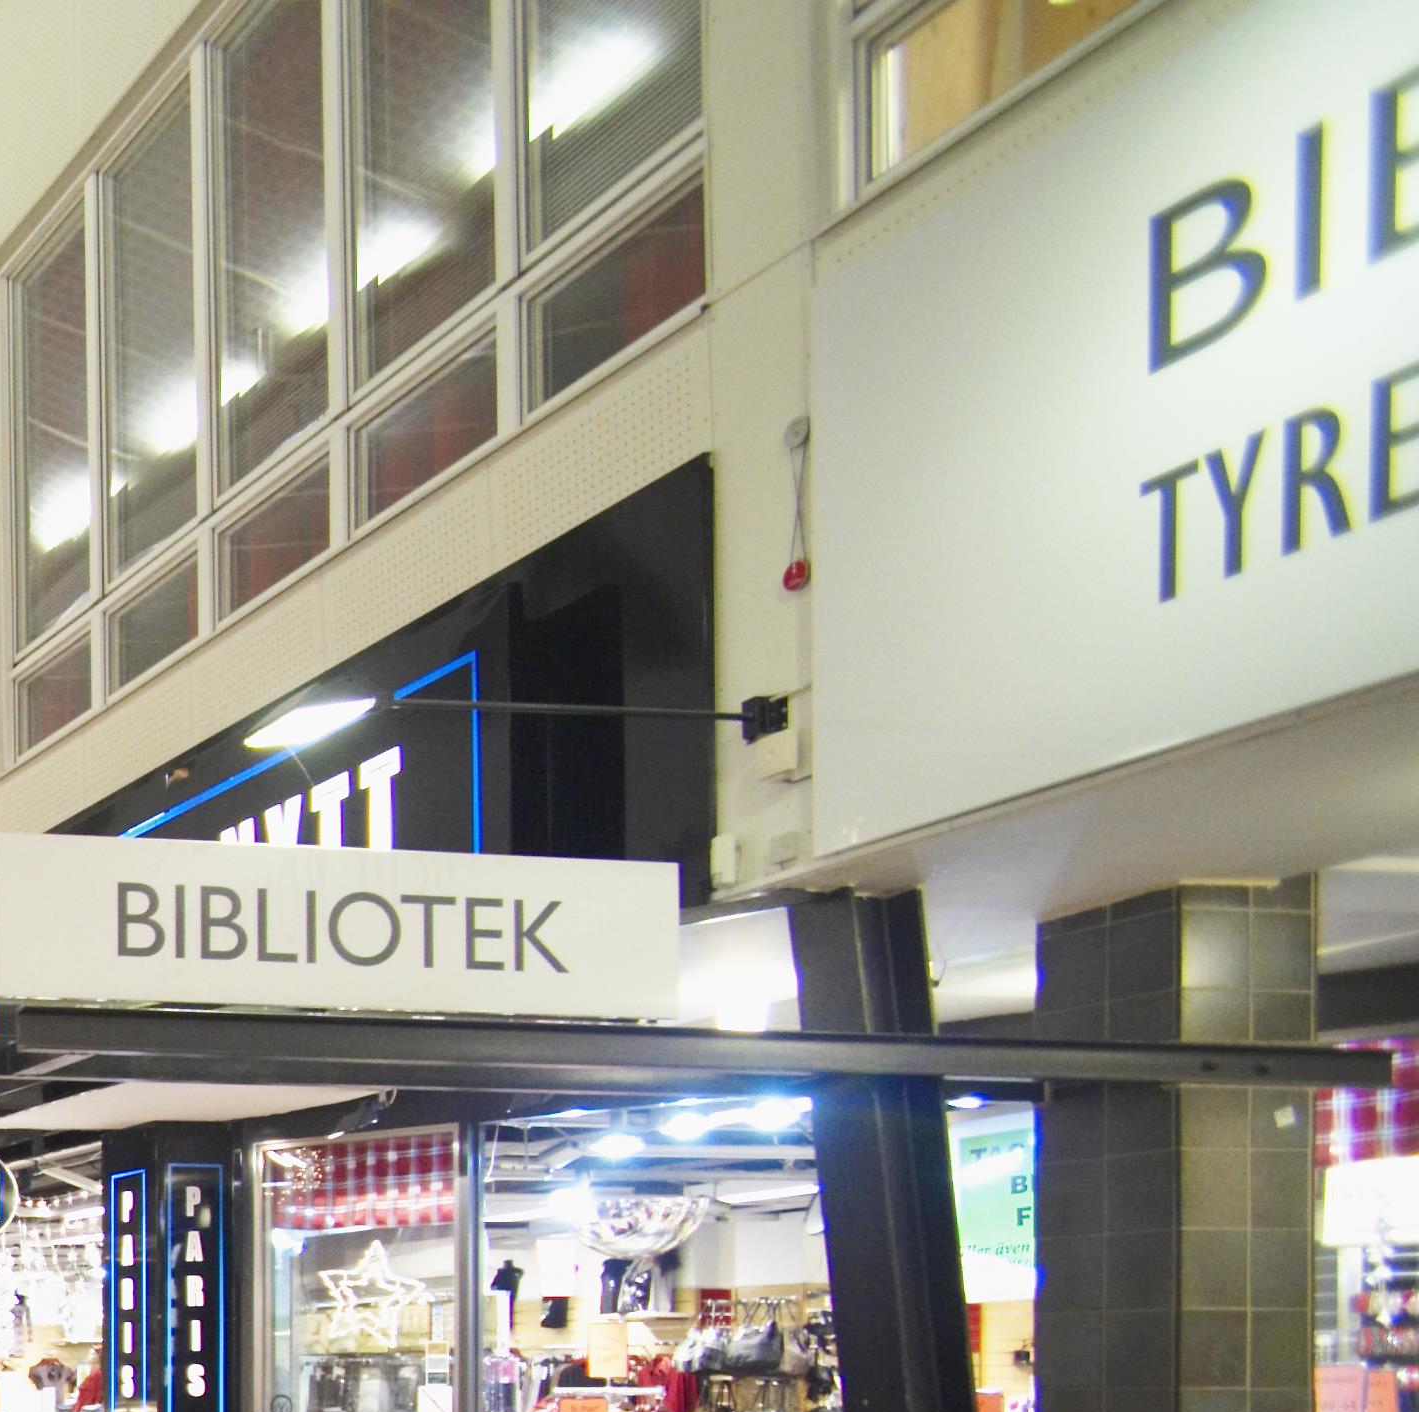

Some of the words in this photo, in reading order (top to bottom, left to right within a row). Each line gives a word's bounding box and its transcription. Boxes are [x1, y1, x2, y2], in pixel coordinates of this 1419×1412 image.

[117, 881, 570, 974] BIBLIOTEK
[120, 1190, 136, 1399] PARIS
[184, 1185, 207, 1398] PARIS
